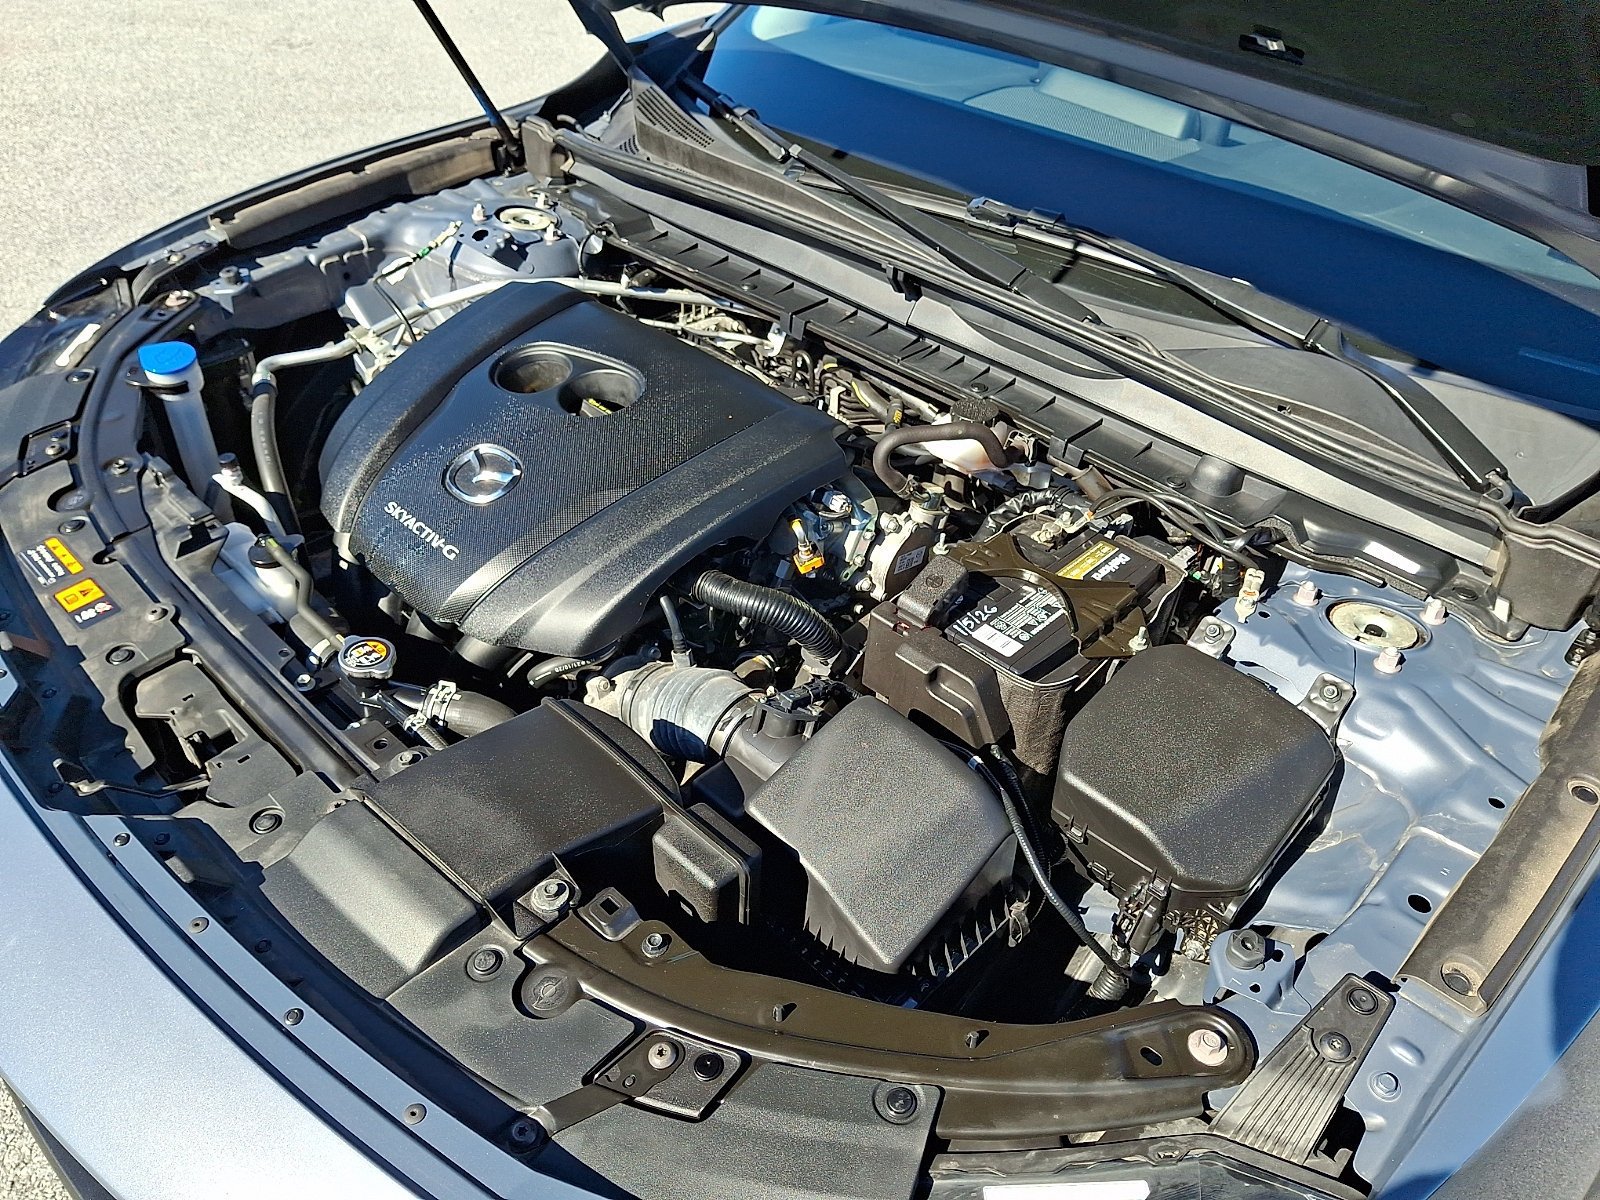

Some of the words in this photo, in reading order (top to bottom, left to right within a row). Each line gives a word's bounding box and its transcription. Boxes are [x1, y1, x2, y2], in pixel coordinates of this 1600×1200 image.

[384, 501, 460, 561] SKYACTIV-G
[1091, 553, 1131, 581] DieHard
[953, 605, 998, 636] 1/5/26
